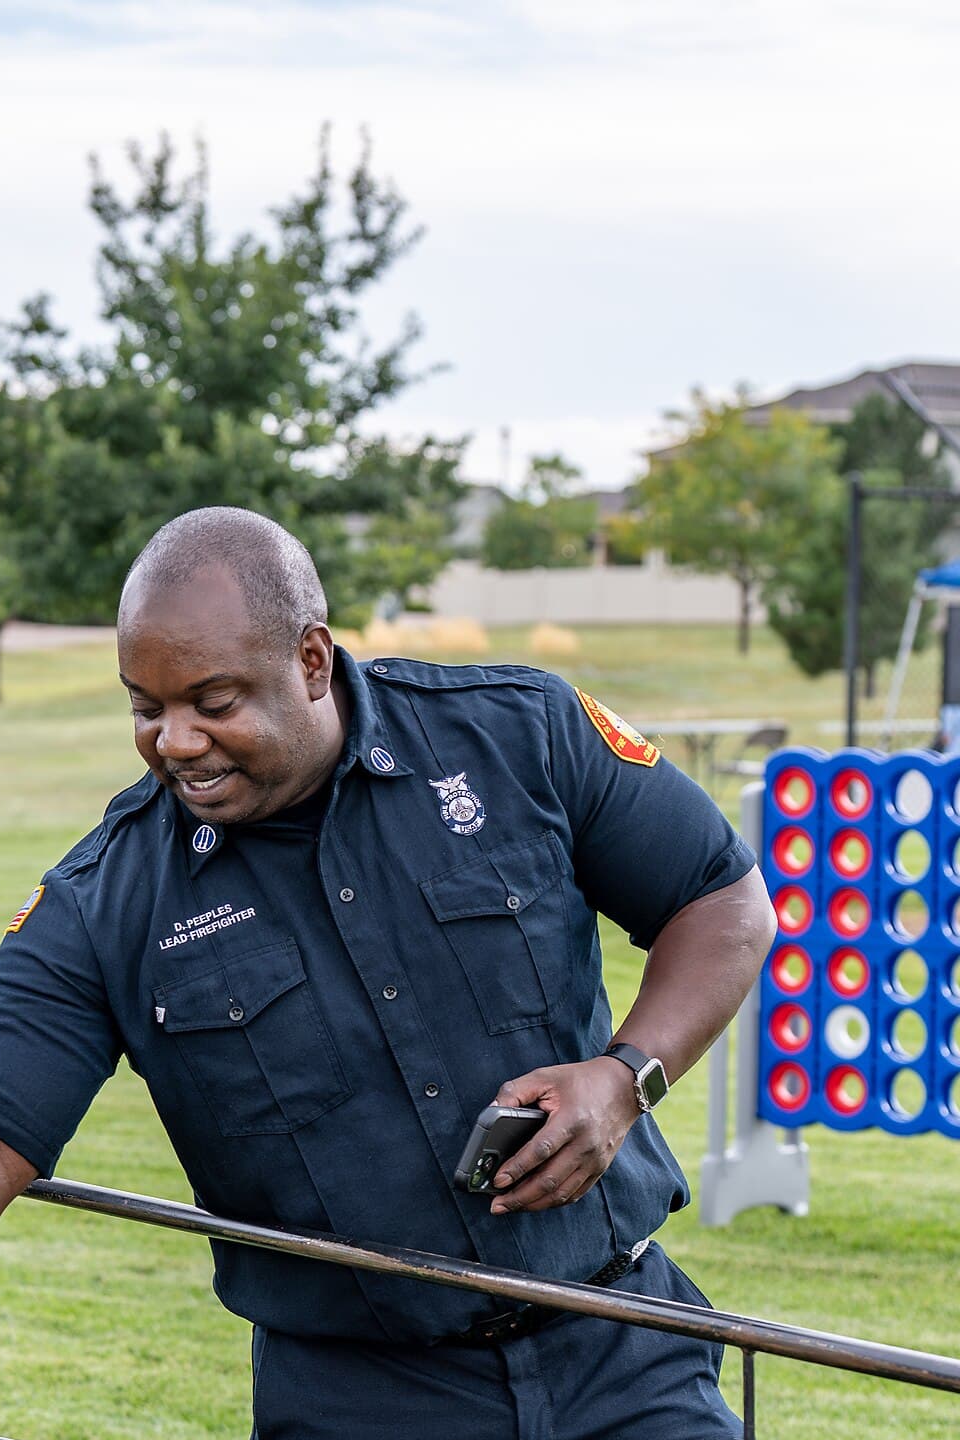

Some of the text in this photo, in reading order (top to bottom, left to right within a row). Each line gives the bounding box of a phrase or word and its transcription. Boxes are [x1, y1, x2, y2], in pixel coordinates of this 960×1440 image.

[444, 790, 482, 808] PROTECTION
[460, 821, 480, 833] USAF
[173, 903, 233, 932] D. PEEPLES
